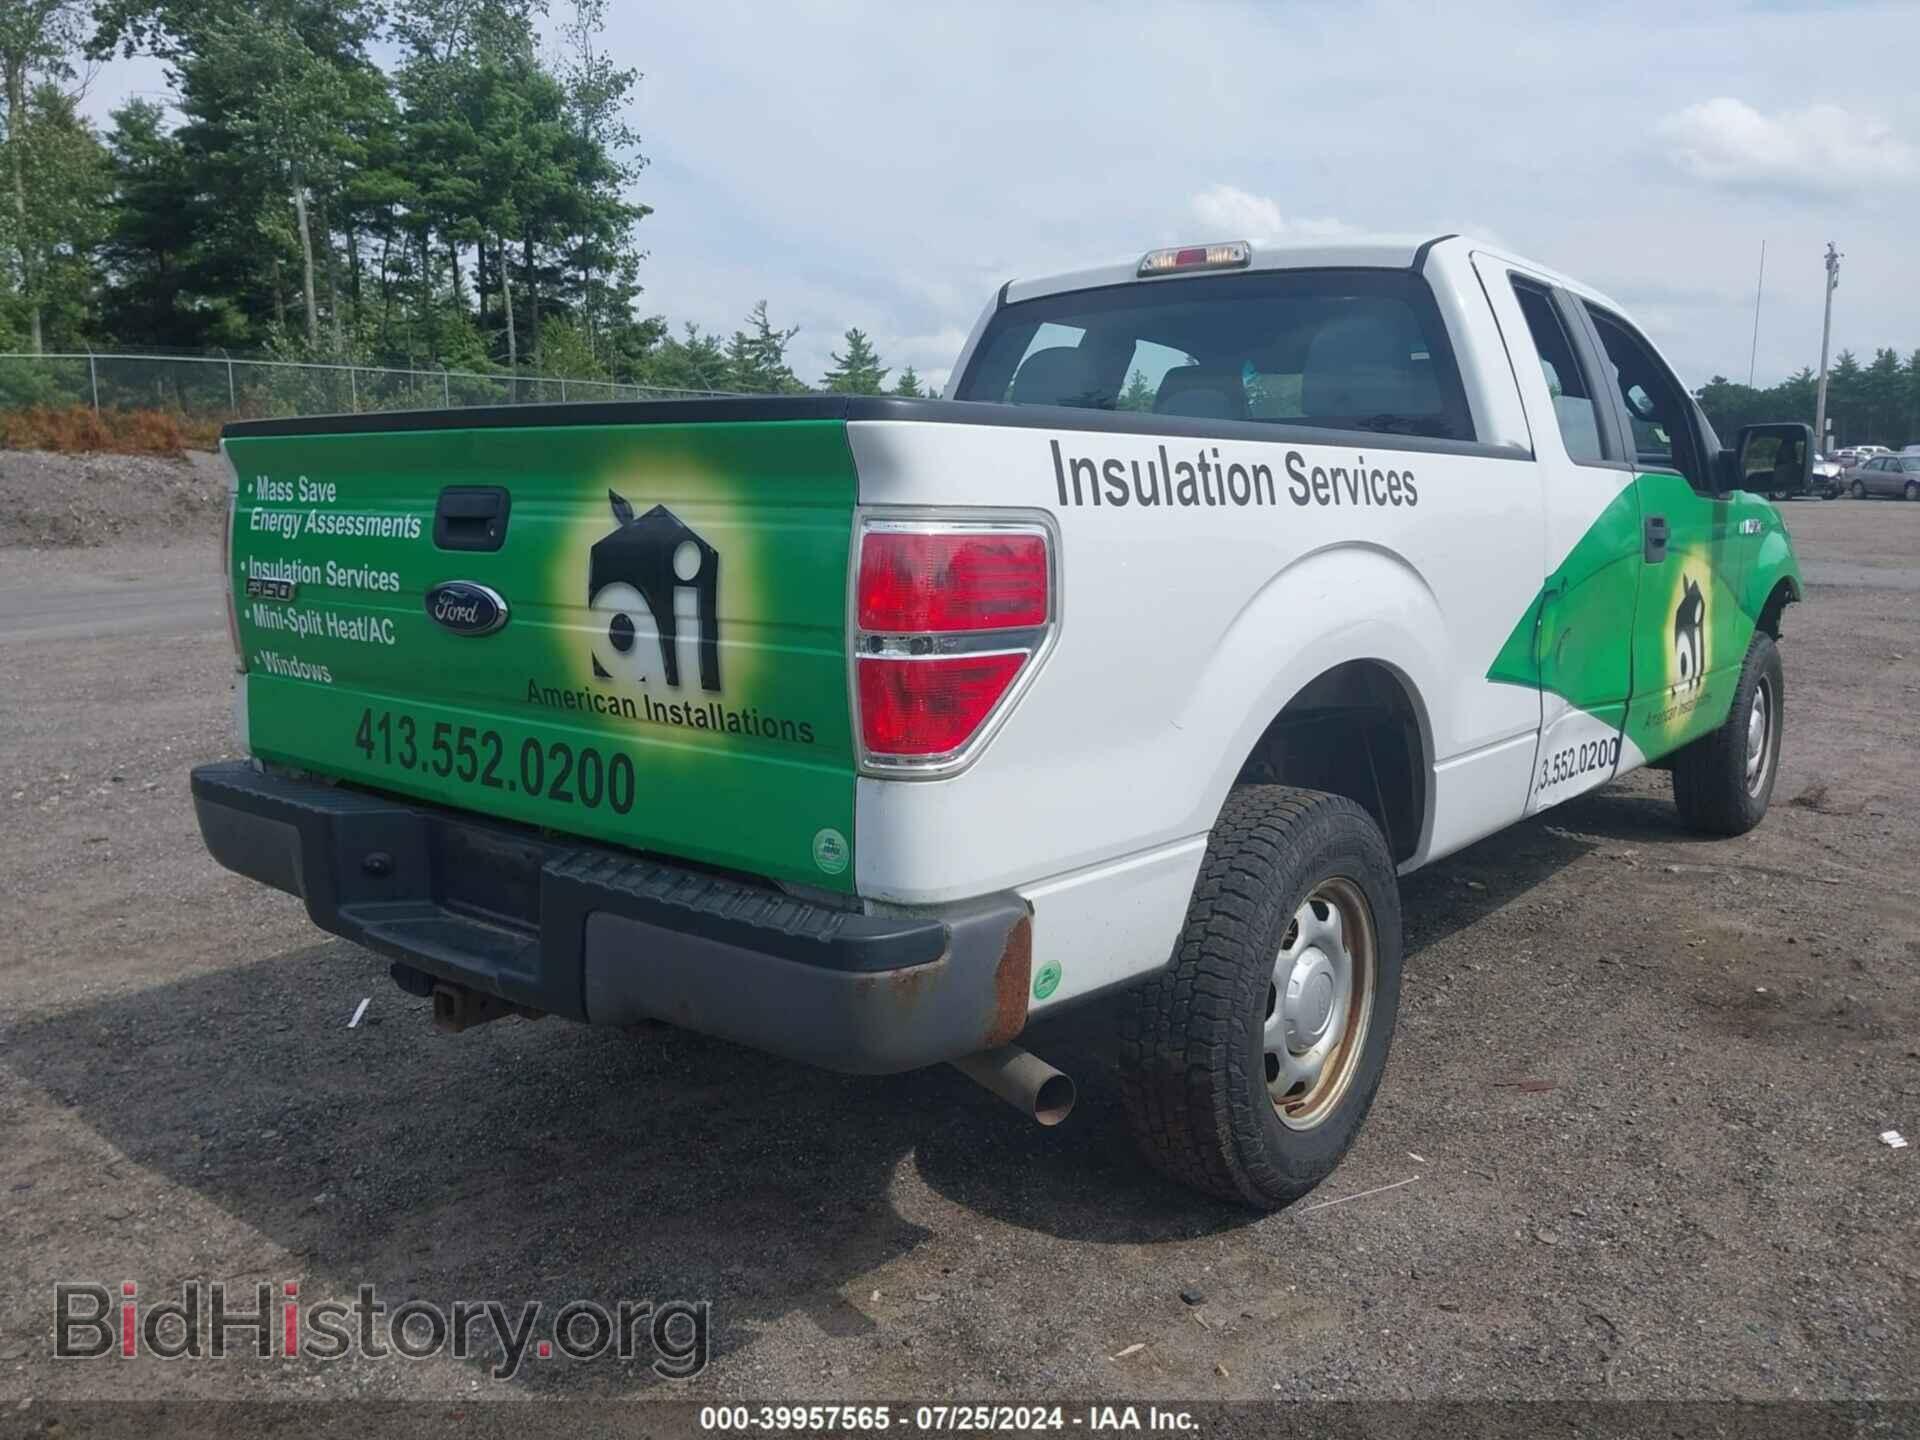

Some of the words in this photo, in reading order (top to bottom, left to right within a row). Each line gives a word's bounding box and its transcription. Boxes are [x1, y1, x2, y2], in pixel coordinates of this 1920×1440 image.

[256, 475, 294, 501] Mass
[298, 475, 336, 502] Save
[1050, 440, 1276, 507] Insulation
[1285, 450, 1418, 507] Services
[250, 507, 302, 539] Energy
[304, 509, 421, 538] Assessments
[249, 555, 321, 585] Insulation
[326, 560, 400, 592] Services
[252, 603, 324, 638] Mini-Split
[326, 612, 396, 645] Heat/AC
[434, 590, 480, 625] Ford
[260, 650, 333, 683] Windows
[527, 679, 636, 719] American
[644, 695, 815, 744] Installations
[355, 707, 635, 815] 413.552.0200
[1535, 737, 1620, 794] 3.552.0200
